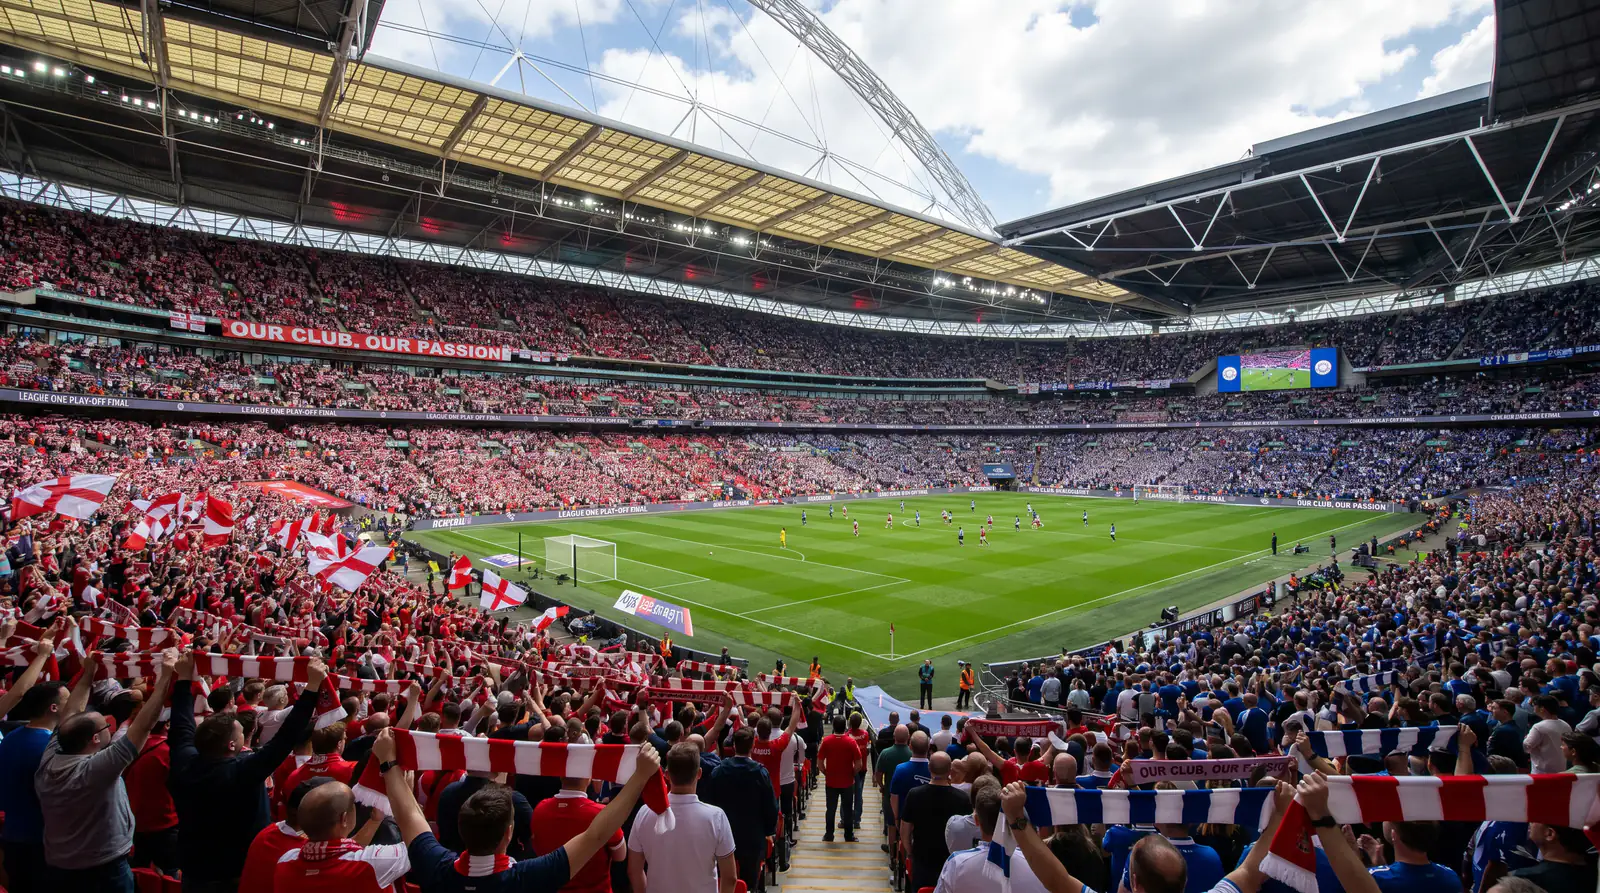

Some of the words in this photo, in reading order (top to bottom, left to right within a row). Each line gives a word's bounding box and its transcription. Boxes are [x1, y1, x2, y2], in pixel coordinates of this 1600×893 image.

[230, 321, 285, 341] OUR
[291, 328, 360, 349] CLUB.
[365, 335, 411, 353] OUR
[417, 340, 501, 360] PASSION
[19, 391, 49, 402] LEAGUE
[50, 394, 68, 404] ONE
[69, 396, 106, 406] PLAY-OFF
[107, 398, 129, 407] FINAL
[241, 406, 269, 414] LEAGUE
[270, 407, 285, 415] ONE
[286, 408, 318, 416] PLAY-OFF
[1335, 501, 1351, 509] OUR
[1352, 503, 1386, 511] PASSION
[558, 509, 585, 518] LEAGUE
[585, 508, 599, 516] ONE
[1139, 766, 1166, 779] OUR
[1170, 764, 1207, 777] CLUB,
[1212, 764, 1239, 774] OUR
